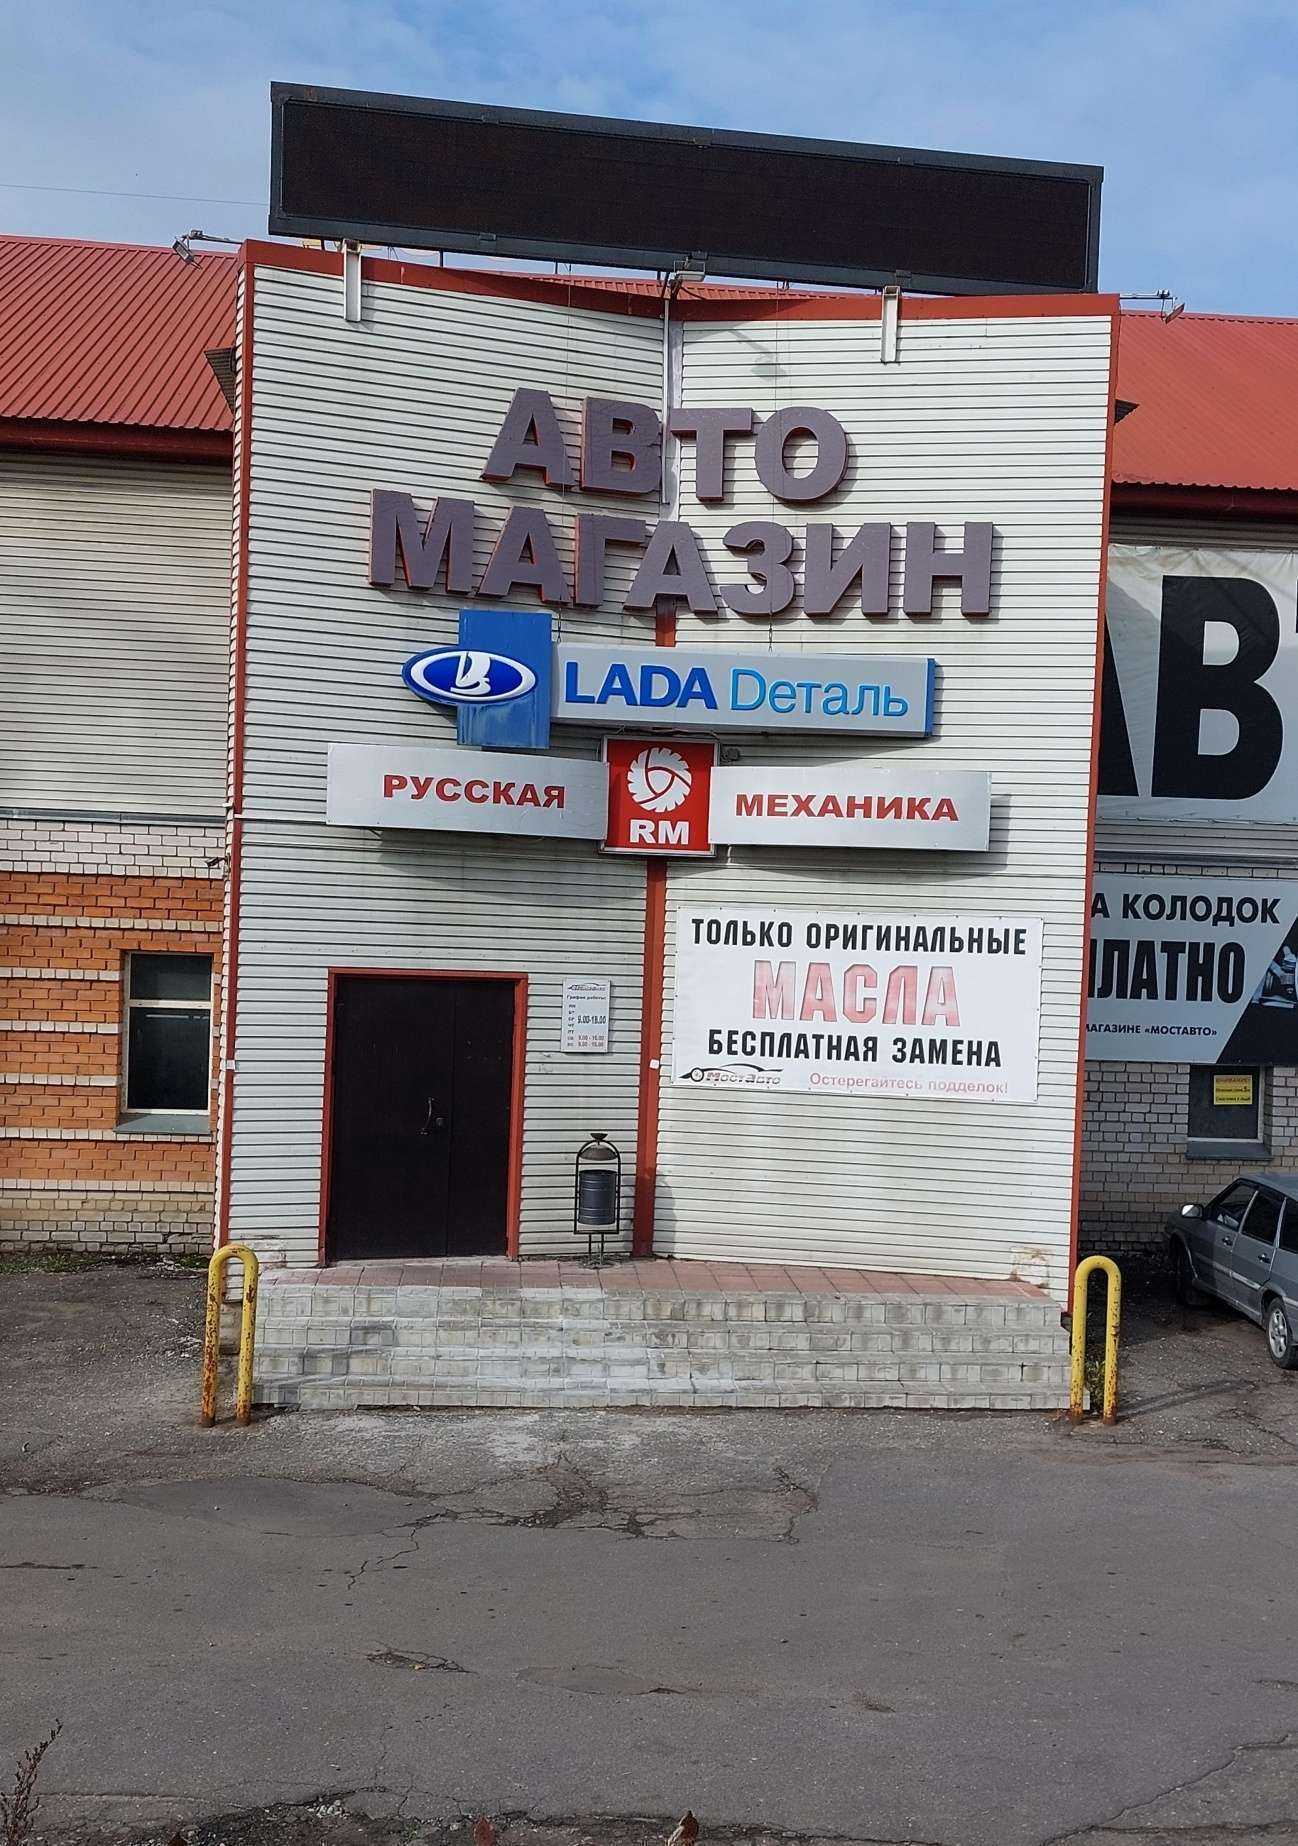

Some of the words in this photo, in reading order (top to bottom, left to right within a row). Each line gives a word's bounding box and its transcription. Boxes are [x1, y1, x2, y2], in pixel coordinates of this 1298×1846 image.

[481, 387, 849, 501] АВТО
[369, 488, 994, 617] МАГАЗИН
[565, 660, 719, 711] LADA
[382, 773, 566, 810] РУССКАЯ
[735, 792, 960, 823] МЕХАНИКА
[629, 819, 690, 847] RM
[1122, 893, 1282, 928] КОЛОДОК
[691, 917, 794, 949] ТОЛЬКО
[805, 921, 1028, 956] ОРИГИНАЛЬНЫЕ
[752, 959, 961, 1028] МАСЛА
[707, 1029, 879, 1063] БЕСПЛАТНАЯ
[892, 1037, 1002, 1068] ЗАМЕНА
[1144, 1024, 1218, 1036] «МОСТАВТО»
[928, 1079, 1009, 1094] подделок!
